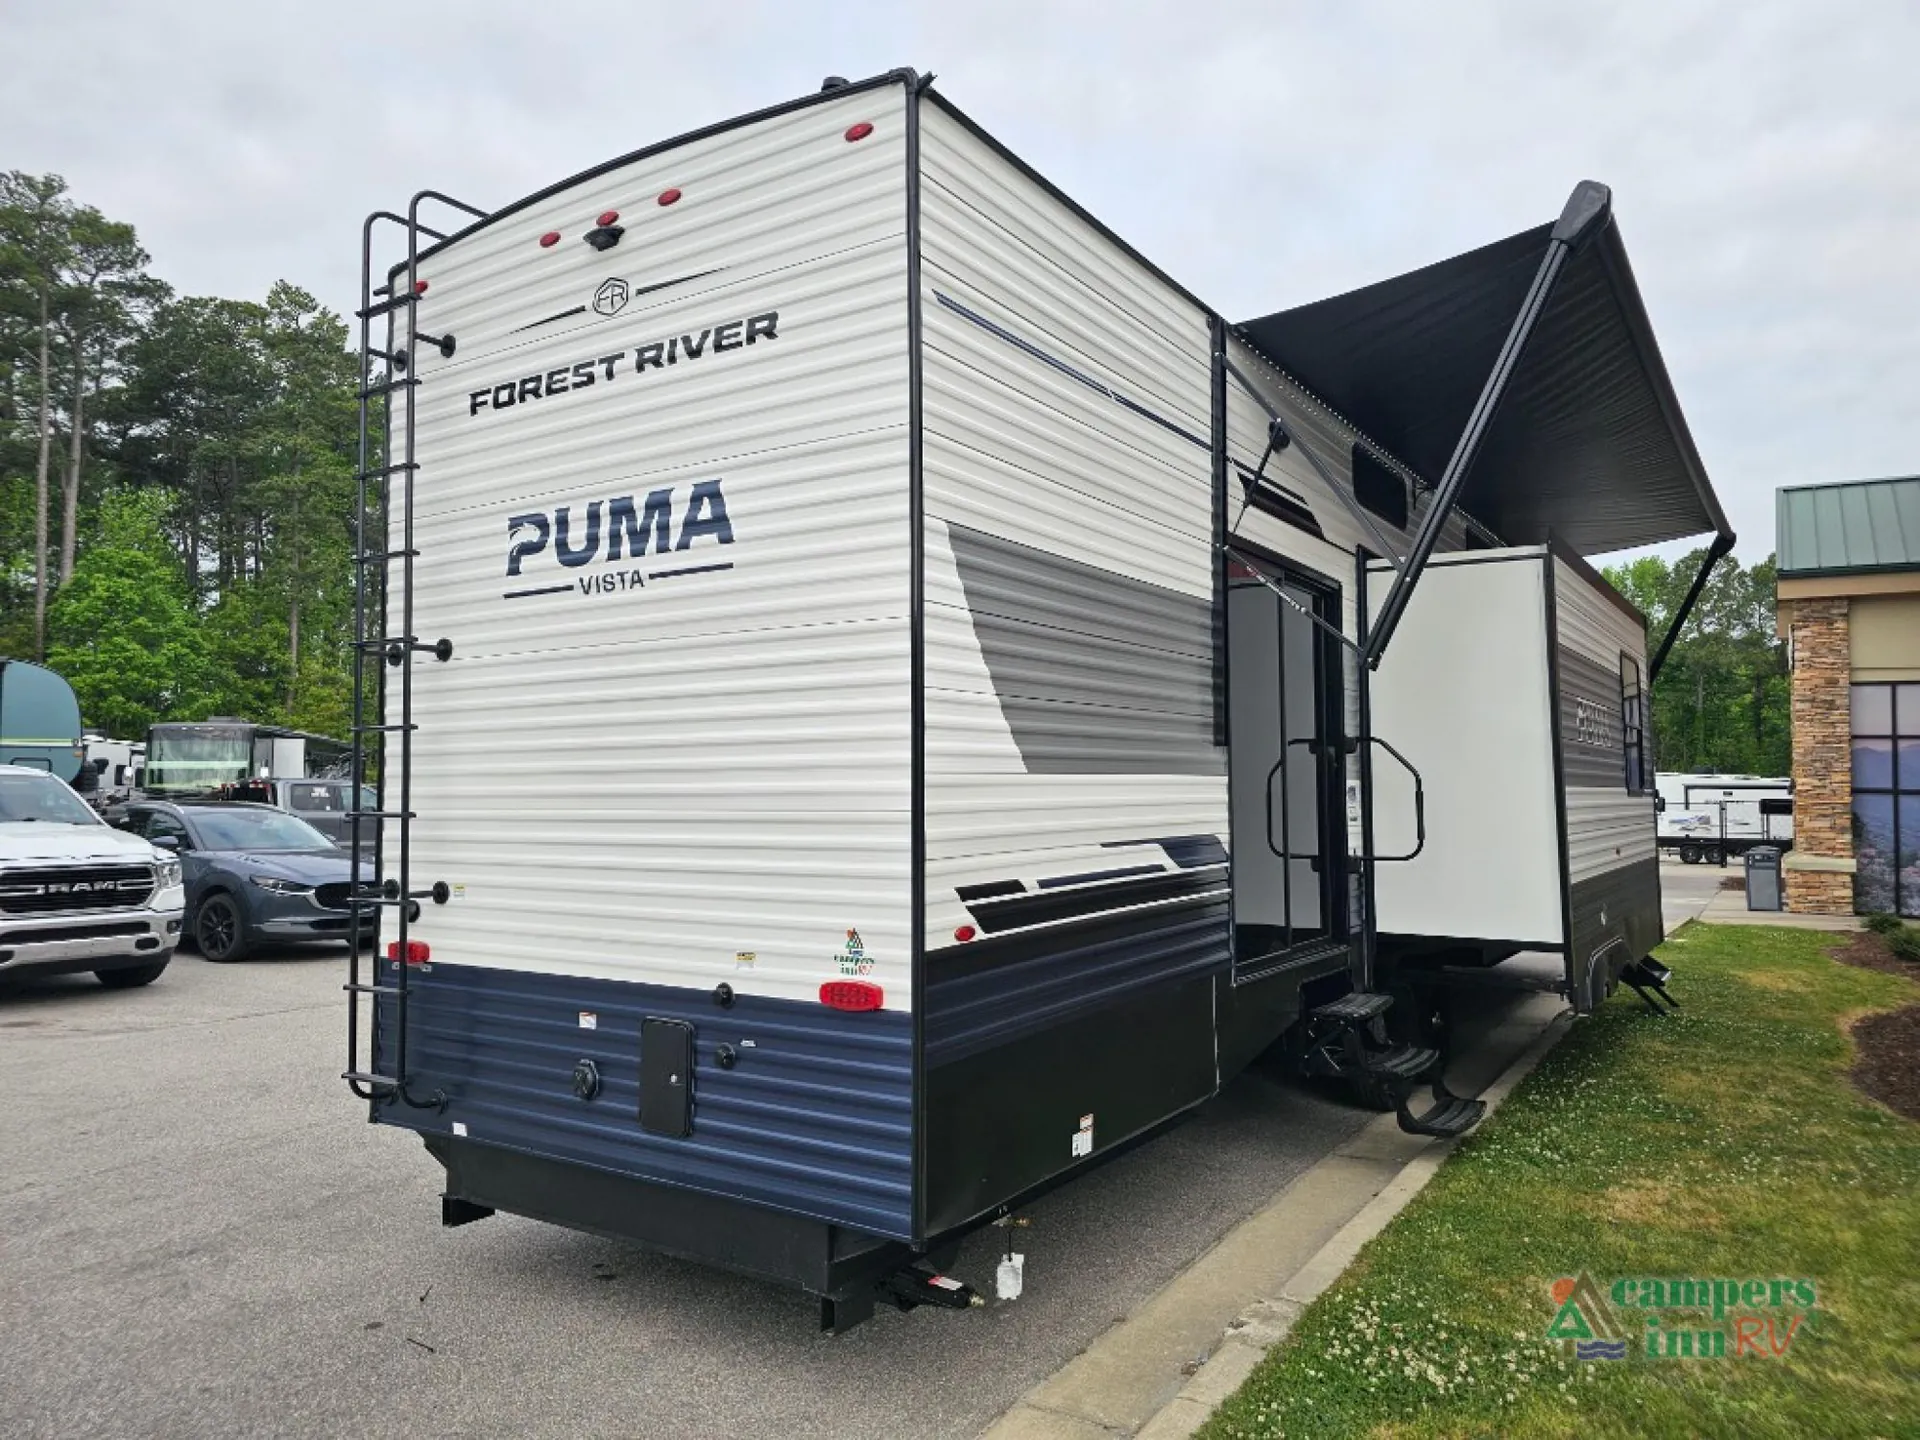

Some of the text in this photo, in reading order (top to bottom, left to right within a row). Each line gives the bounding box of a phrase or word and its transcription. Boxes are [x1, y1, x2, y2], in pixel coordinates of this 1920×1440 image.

[469, 311, 780, 416] FOREST RIVER
[506, 478, 736, 576] PUMA
[578, 569, 646, 596] VISTA
[48, 881, 115, 893] RAM
